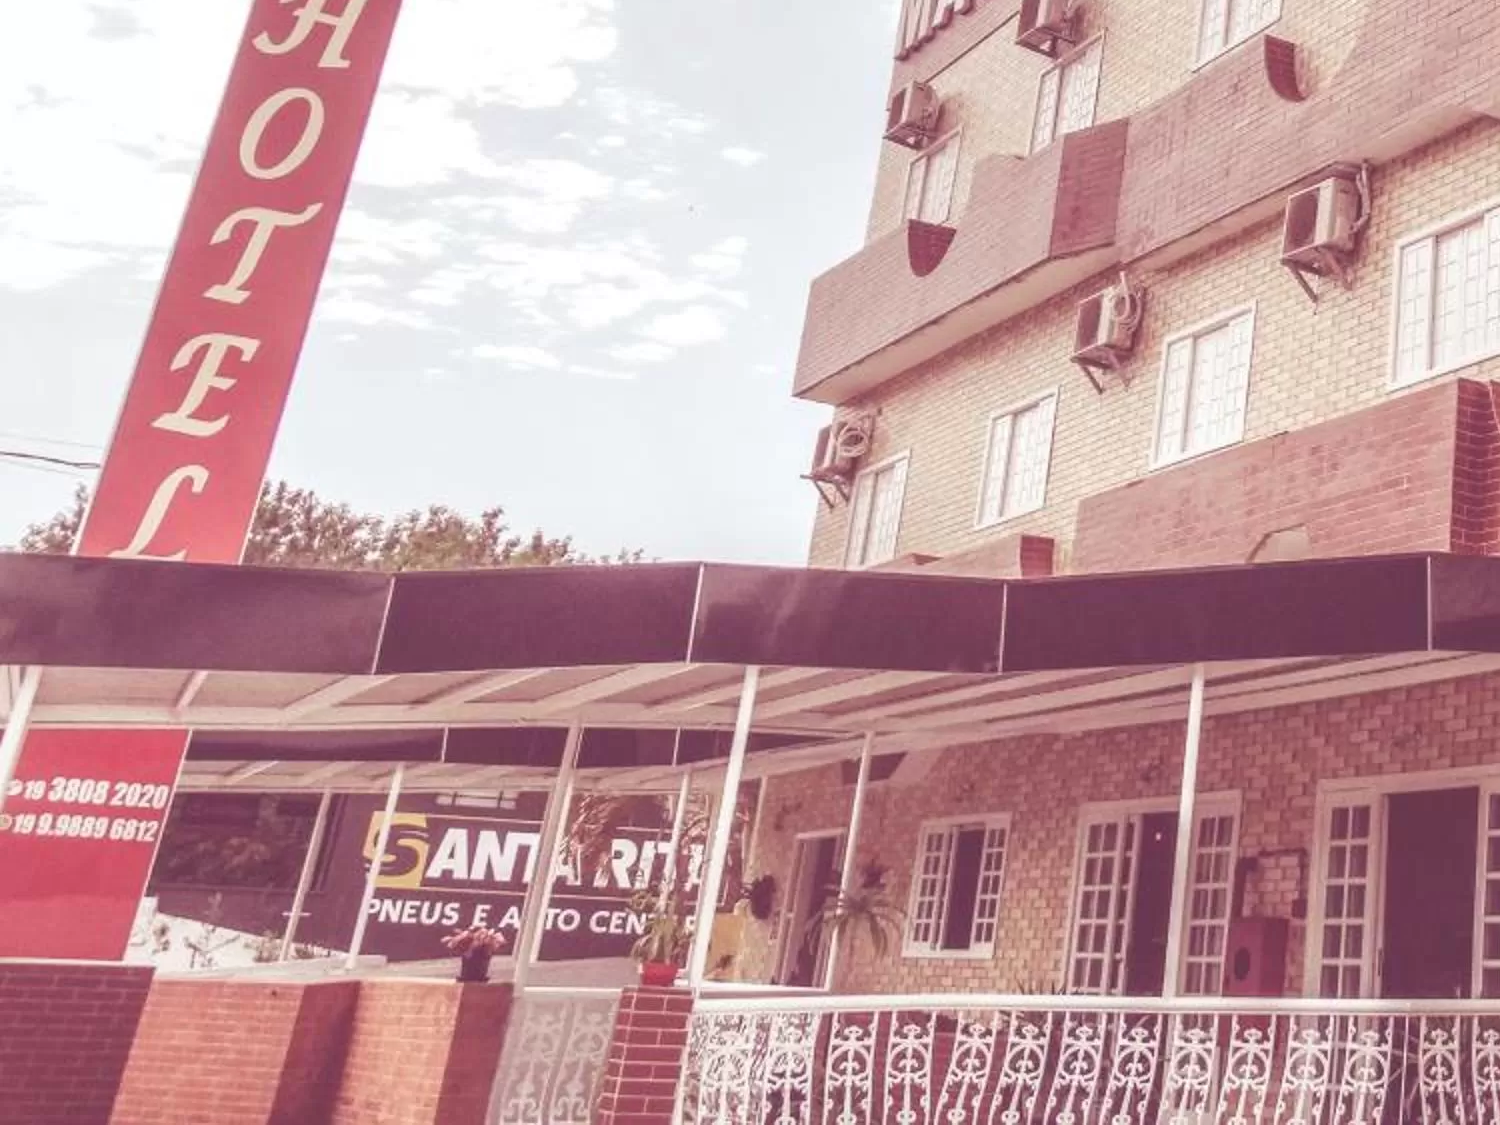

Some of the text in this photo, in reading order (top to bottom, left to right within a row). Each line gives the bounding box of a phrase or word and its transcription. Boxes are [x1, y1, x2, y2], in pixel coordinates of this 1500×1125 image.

[23, 776, 171, 810] 19 3808 2020
[11, 812, 37, 835] 19
[367, 898, 461, 926] PNEUS
[471, 904, 492, 928] E
[498, 905, 581, 933] ATO
